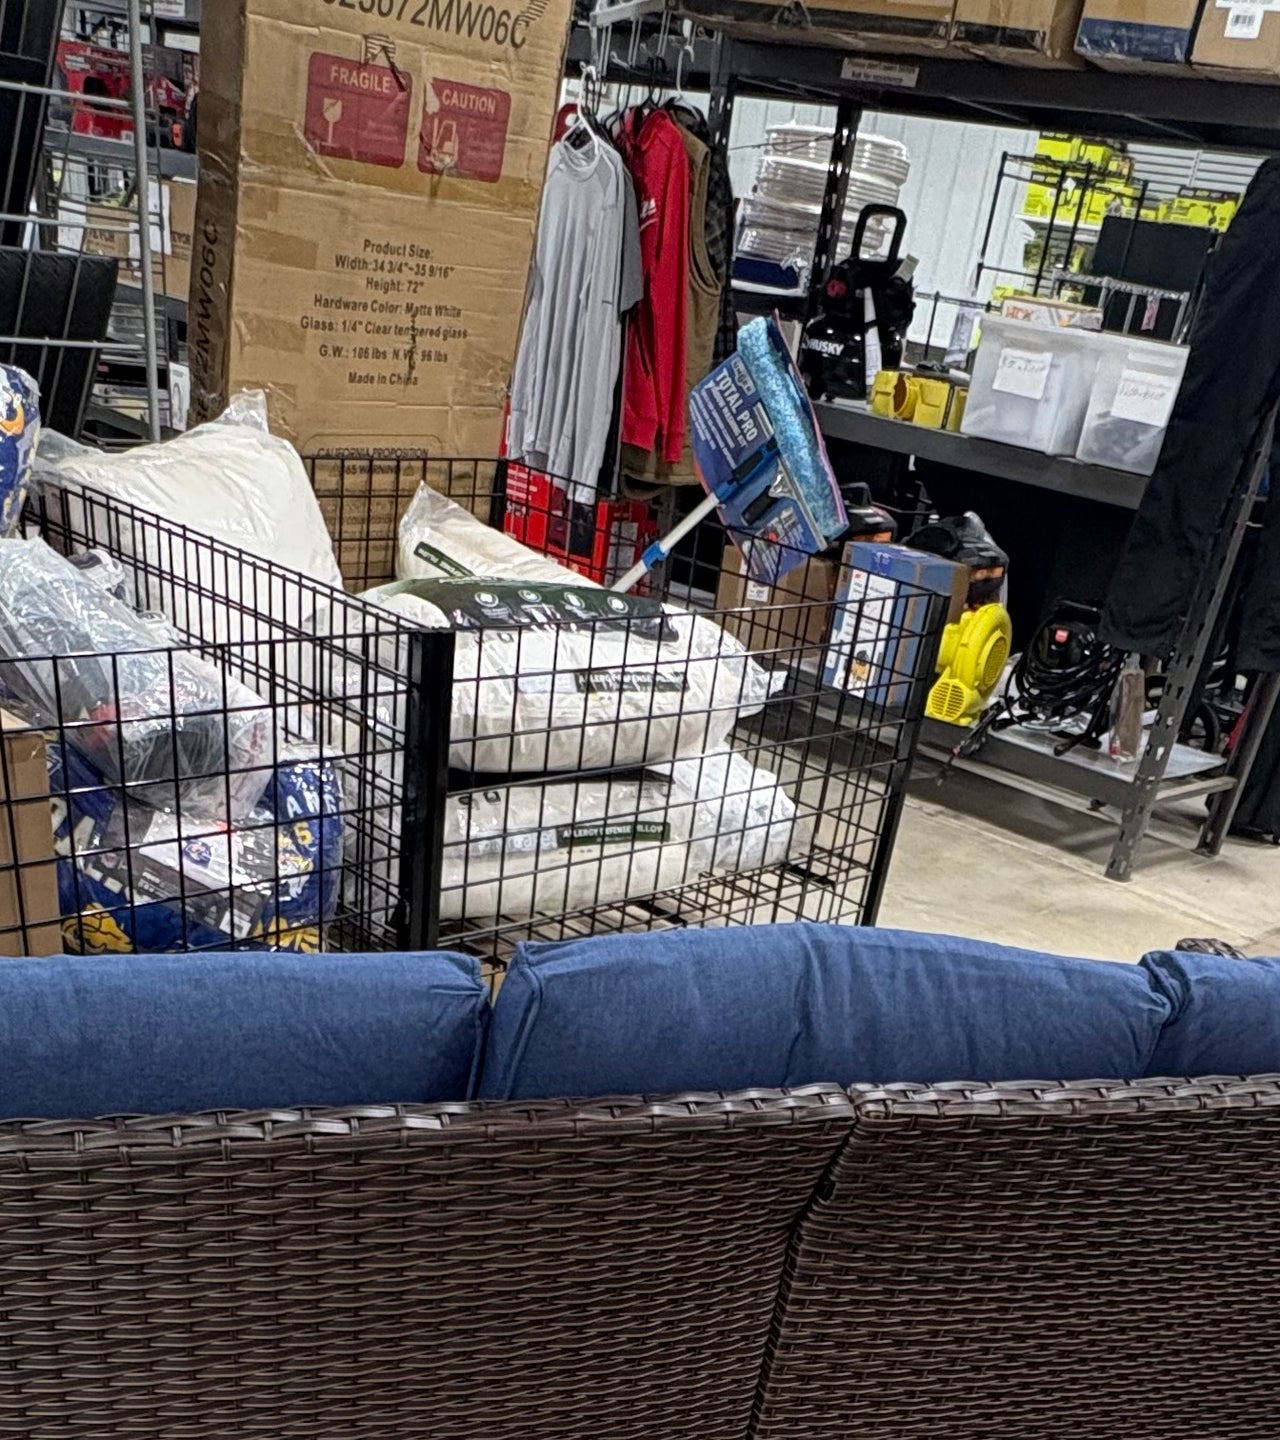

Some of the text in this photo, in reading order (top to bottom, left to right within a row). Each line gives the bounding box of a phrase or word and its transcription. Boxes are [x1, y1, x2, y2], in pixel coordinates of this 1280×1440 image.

[330, 65, 393, 94] FRAGILE
[442, 89, 496, 114] CAUTION
[364, 239, 434, 259] Product Size:
[366, 277, 424, 295] Height: 72"
[314, 294, 462, 319] Hardware Color: Matte White
[300, 315, 338, 333] Glass:
[341, 319, 364, 333] 1/4"
[364, 321, 393, 336] Clear
[442, 326, 468, 342] glass
[371, 347, 387, 361] lbs
[434, 350, 449, 364] lbs
[809, 338, 845, 356] HUSKY
[348, 371, 419, 387] Made in China
[716, 367, 759, 442] TOTAL PRO
[563, 828, 598, 838] ALERGY
